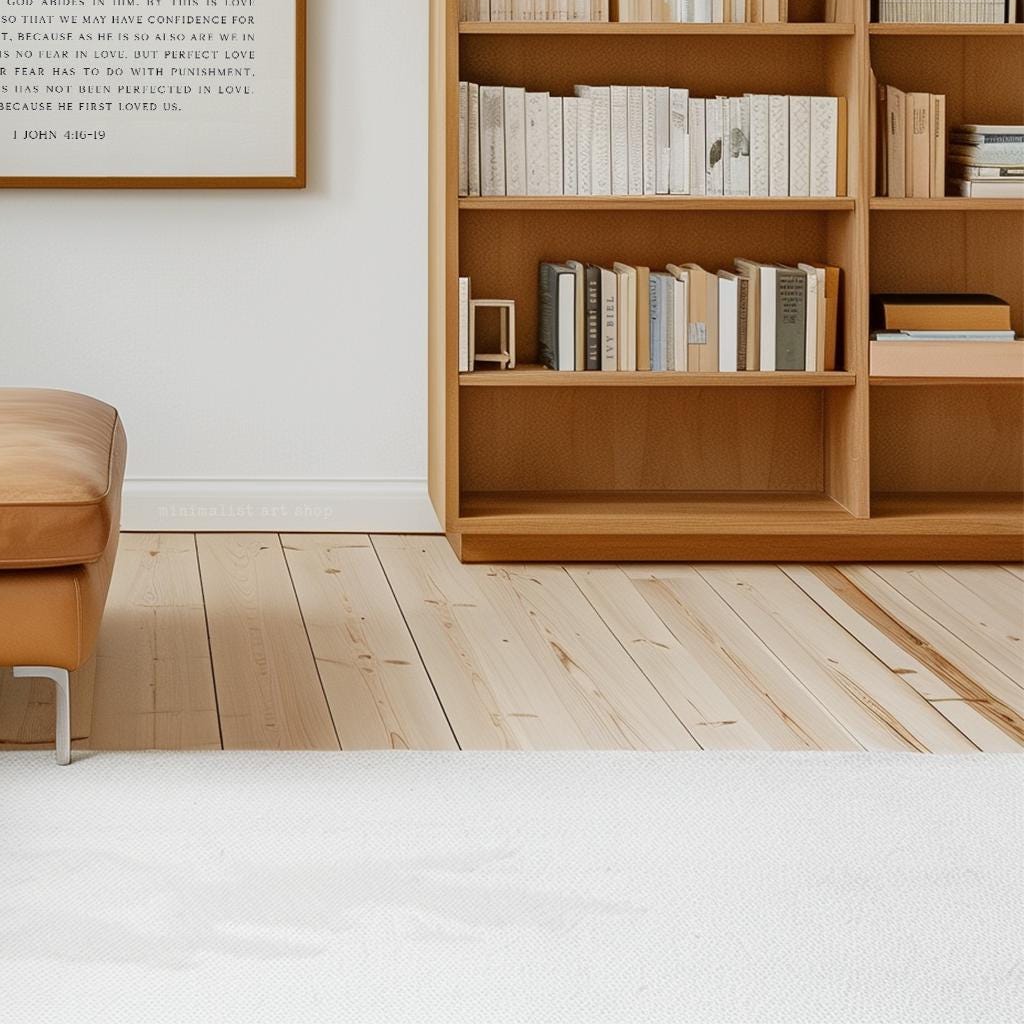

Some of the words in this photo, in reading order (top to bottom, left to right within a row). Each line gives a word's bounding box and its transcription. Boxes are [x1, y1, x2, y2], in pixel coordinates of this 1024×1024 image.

[0, 15, 17, 24] SO
[20, 15, 55, 24] THAT
[58, 15, 78, 24] WE
[81, 15, 107, 24] MAY
[111, 15, 143, 25] HAVE
[146, 15, 227, 25] CONFIDENCE
[231, 15, 255, 25] FOR
[16, 32, 73, 41] BECAUSE
[78, 32, 93, 41] AS
[97, 32, 114, 41] HE
[118, 32, 130, 41] IS
[133, 33, 150, 41] SO
[152, 32, 186, 41] ALSO
[190, 32, 214, 41] ARE
[218, 33, 237, 42] WE
[242, 32, 255, 41] IN
[15, 50, 33, 59] NO
[38, 50, 69, 59] FEAR
[75, 50, 88, 59] IN
[133, 50, 159, 60] BUT
[163, 50, 219, 60] PERFECT
[224, 50, 255, 60] LOVE
[14, 67, 45, 76] FEAR
[52, 67, 76, 76] HAS
[82, 67, 100, 76] TO
[106, 67, 124, 77] DO
[130, 67, 164, 77] WITH
[14, 85, 40, 94] HAS
[45, 85, 73, 94] NOT
[78, 85, 111, 94] BEEN
[117, 84, 192, 95] PERFECTED
[198, 85, 211, 94] IN
[57, 102, 73, 111] HE
[78, 102, 113, 111] FIRST
[118, 102, 158, 111] LOVED
[23, 129, 57, 140] JOHN
[63, 130, 106, 140] 4:16-19
[589, 280, 597, 303] CATS
[606, 296, 615, 328] BIEL
[589, 309, 597, 339] ABOUT
[606, 335, 615, 359] IVY
[589, 345, 597, 361] ALL
